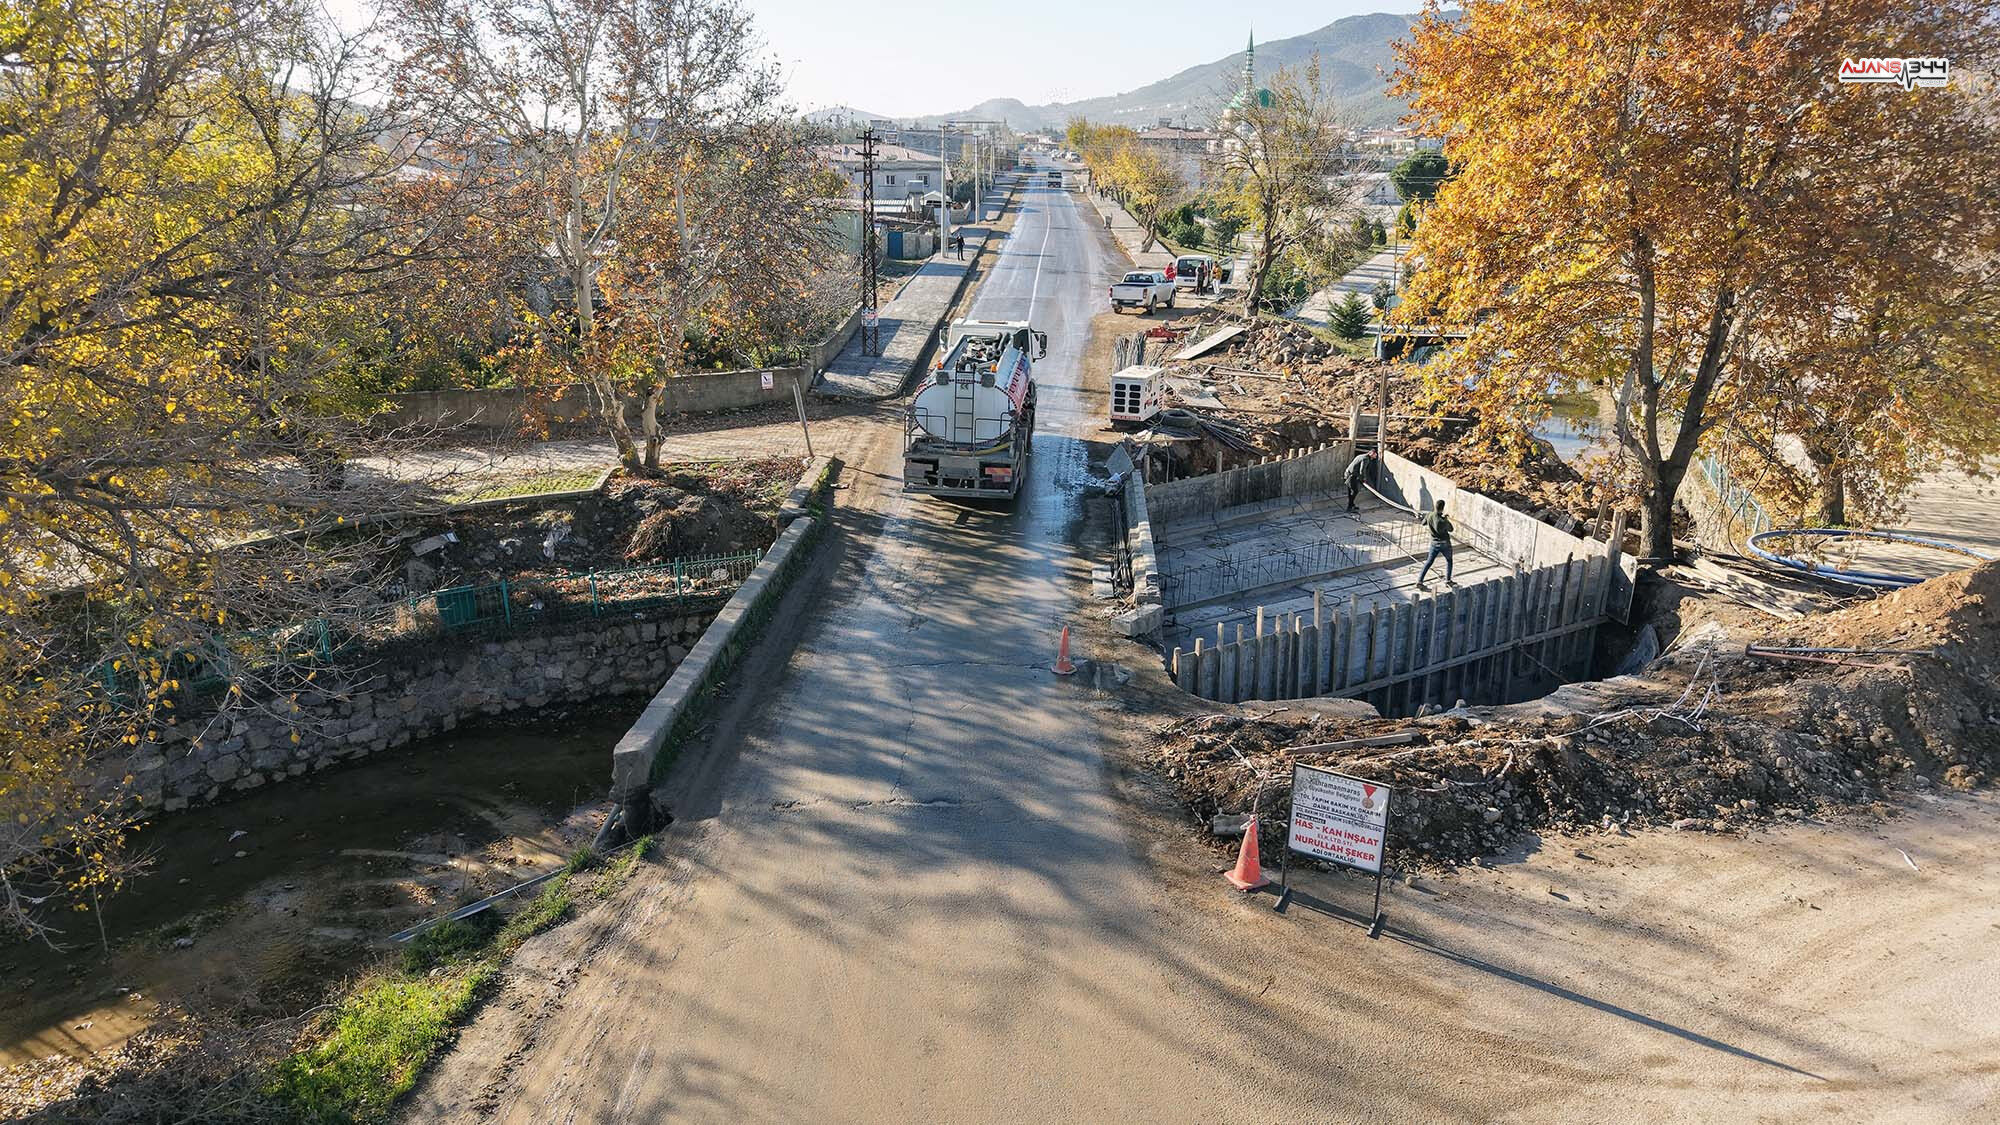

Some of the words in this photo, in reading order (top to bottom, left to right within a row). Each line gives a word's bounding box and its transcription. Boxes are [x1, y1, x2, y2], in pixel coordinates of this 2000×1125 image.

[1295, 818, 1313, 829] HAS
[1322, 825, 1342, 837] KAN
[1344, 829, 1378, 848] İNŞAAT
[1295, 834, 1343, 853] NURULLAH
[1345, 847, 1375, 863] ŞEKER
[1323, 850, 1355, 863] ORTAKLIĞI
